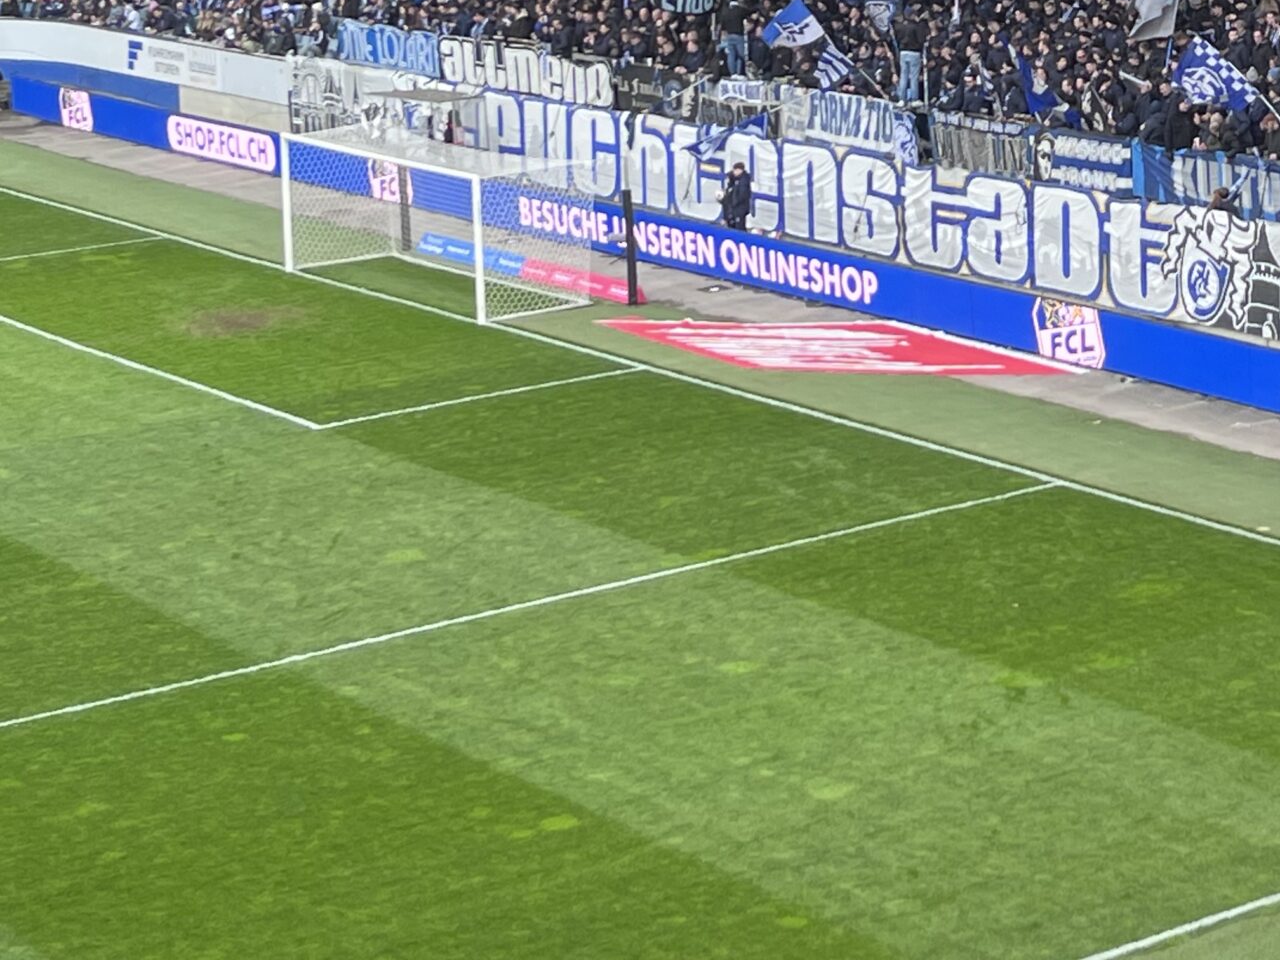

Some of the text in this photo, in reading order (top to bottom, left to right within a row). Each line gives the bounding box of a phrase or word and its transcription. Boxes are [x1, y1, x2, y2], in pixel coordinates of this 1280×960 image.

[68, 106, 87, 124] FCL
[174, 121, 269, 165] SHOP.FCL.CH
[518, 196, 609, 245] BESUCHE
[719, 239, 878, 305] ONLINESHOP
[1051, 328, 1095, 359] FCL
